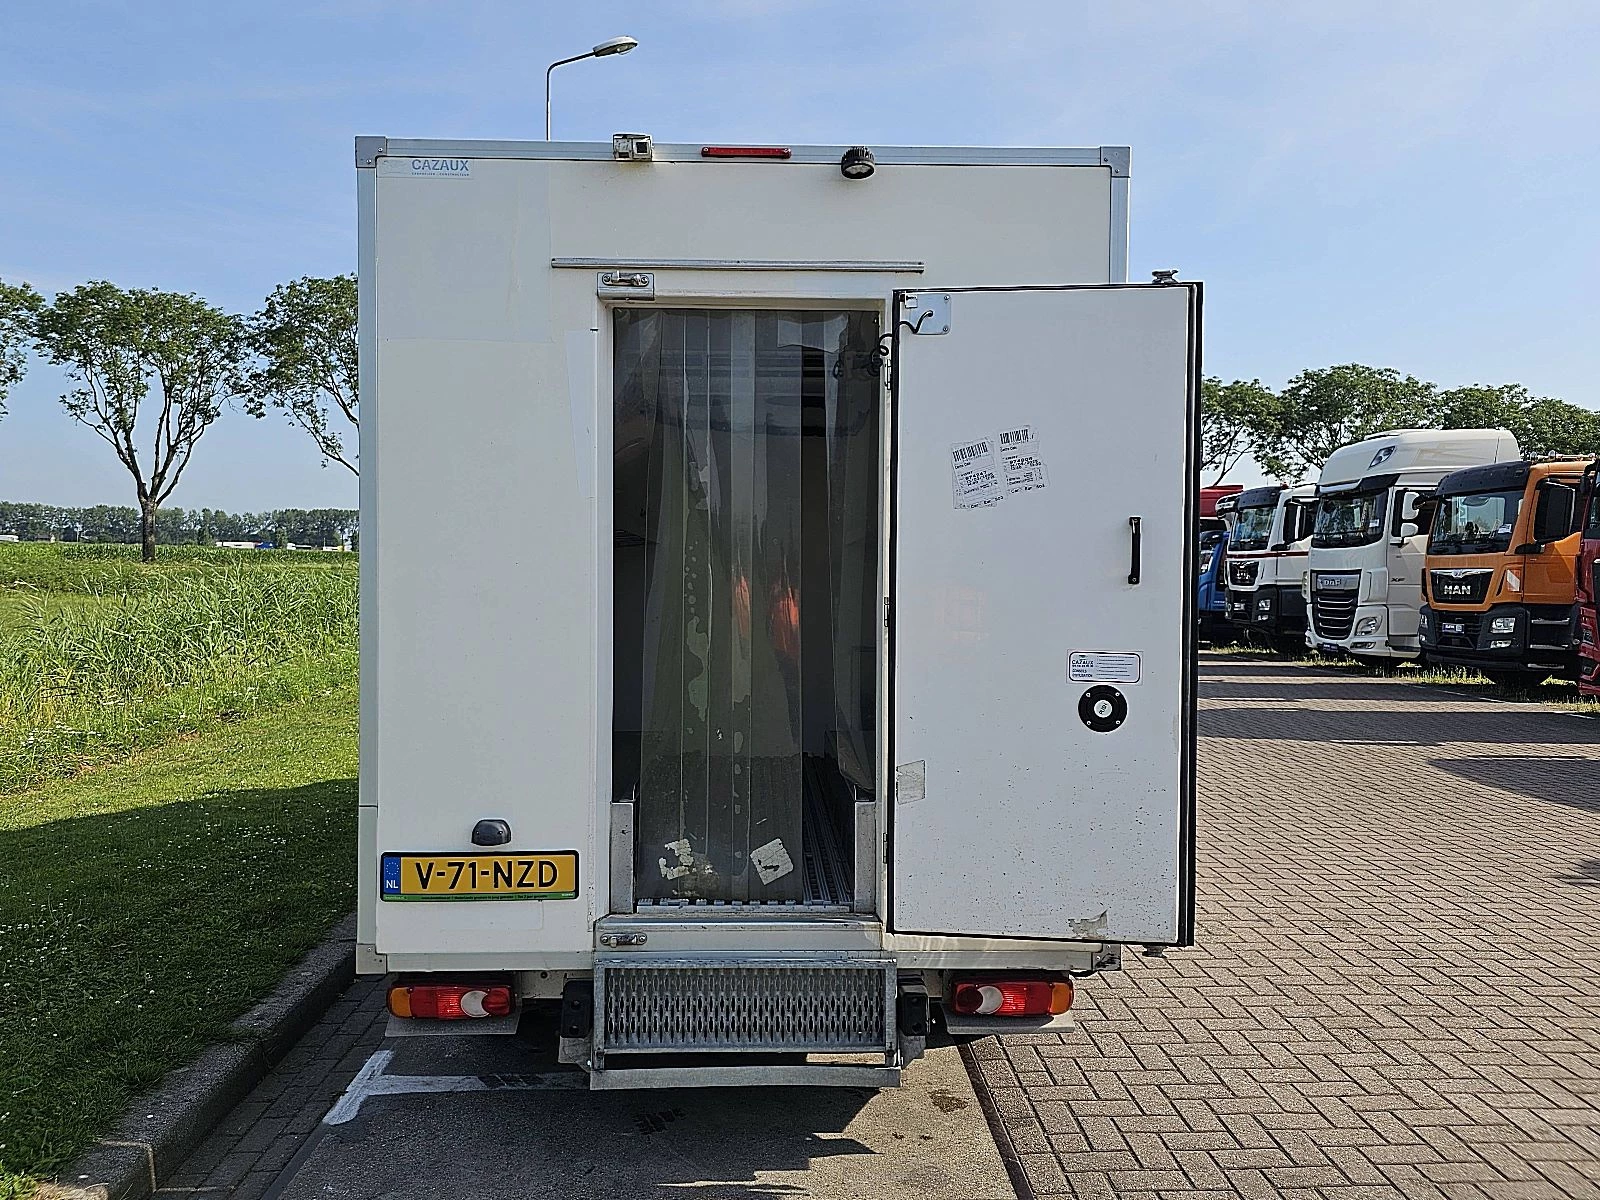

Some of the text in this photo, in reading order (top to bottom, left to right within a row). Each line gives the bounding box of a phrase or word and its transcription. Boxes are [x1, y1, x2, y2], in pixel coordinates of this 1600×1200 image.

[411, 159, 469, 171] CAZAUX
[1443, 585, 1472, 595] MAN
[415, 860, 558, 890] V-71-NZD
[385, 879, 399, 889] NL
